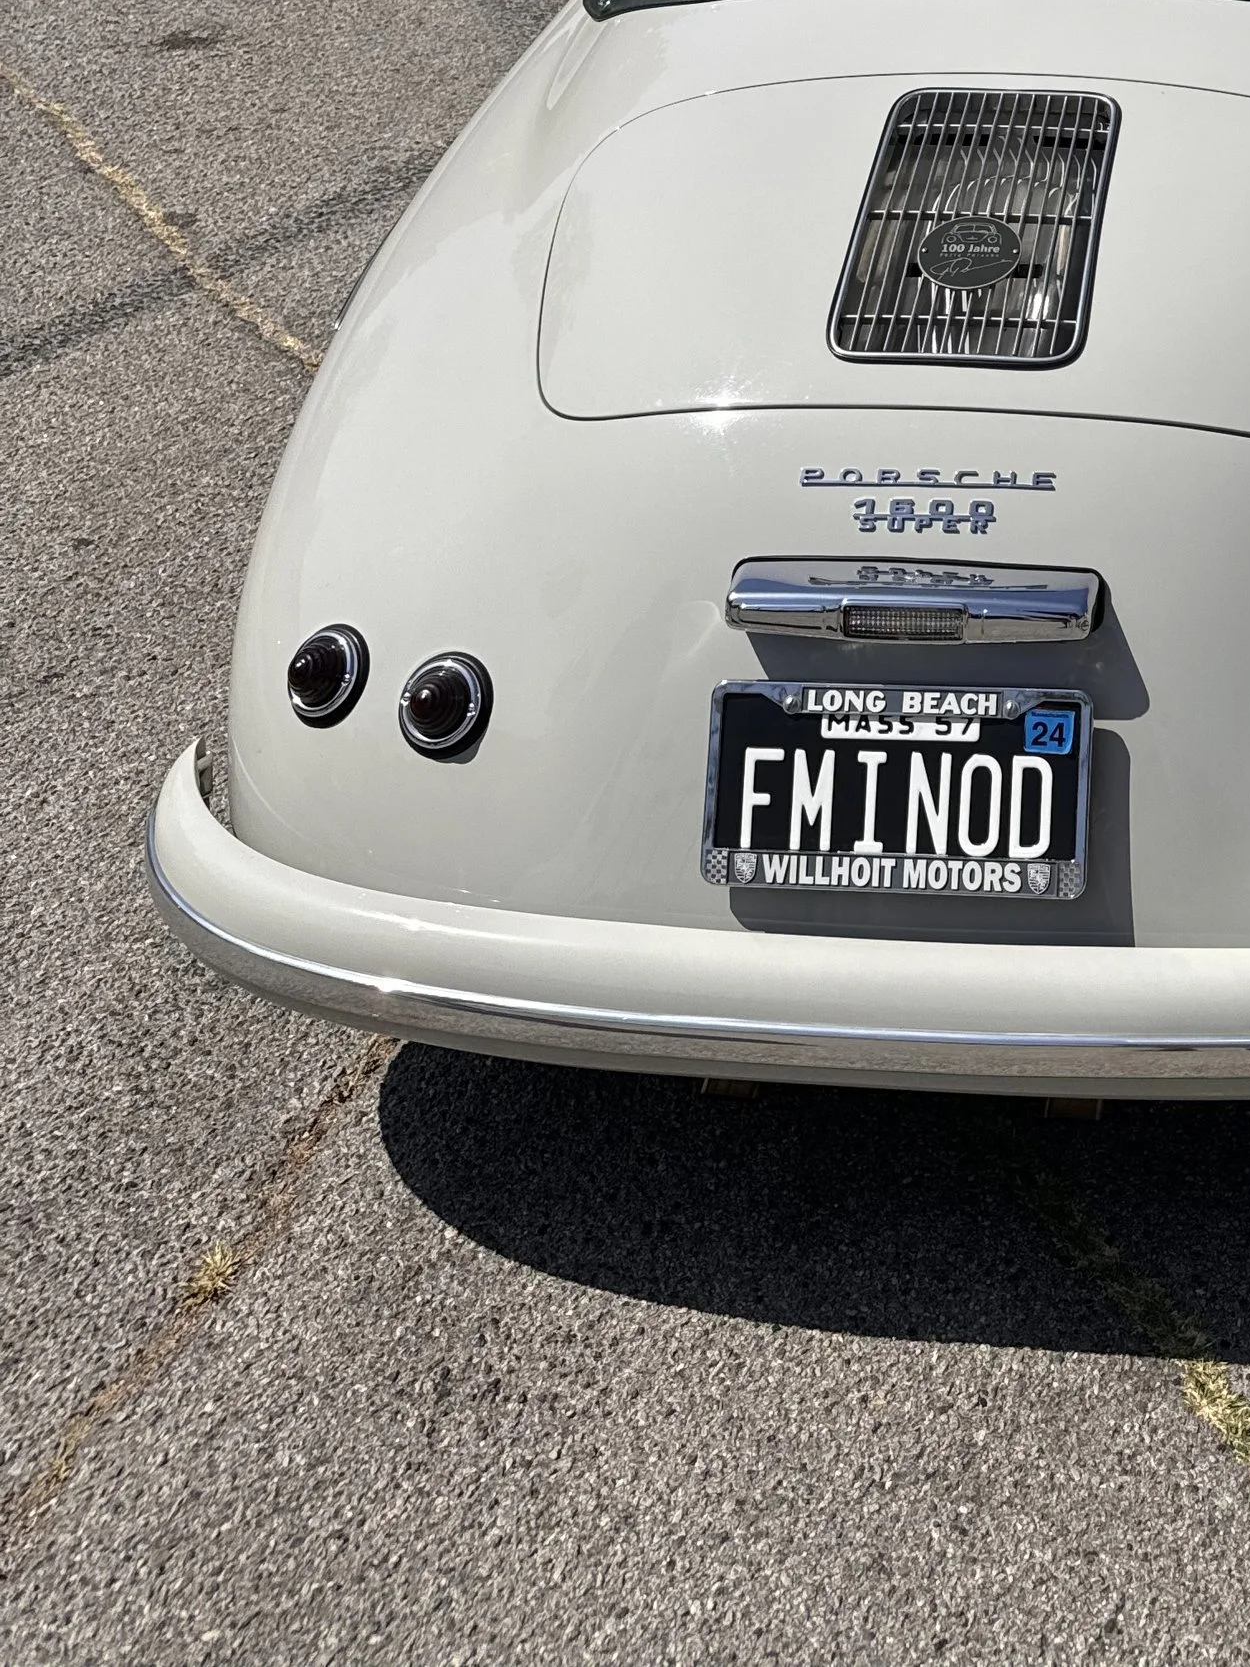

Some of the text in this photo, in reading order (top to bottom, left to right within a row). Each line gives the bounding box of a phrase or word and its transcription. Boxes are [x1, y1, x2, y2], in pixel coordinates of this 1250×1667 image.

[941, 243, 1000, 253] 100 Jahre
[800, 467, 1057, 491] PORSCHE
[853, 498, 996, 521] 1600
[857, 516, 990, 535] SUPER
[806, 688, 998, 717] LONG BEACH
[826, 714, 916, 736] MASS
[1030, 720, 1067, 748] 24
[739, 746, 1054, 860] FMINOD
[762, 853, 1023, 893] WILLHOIT MOTORS
